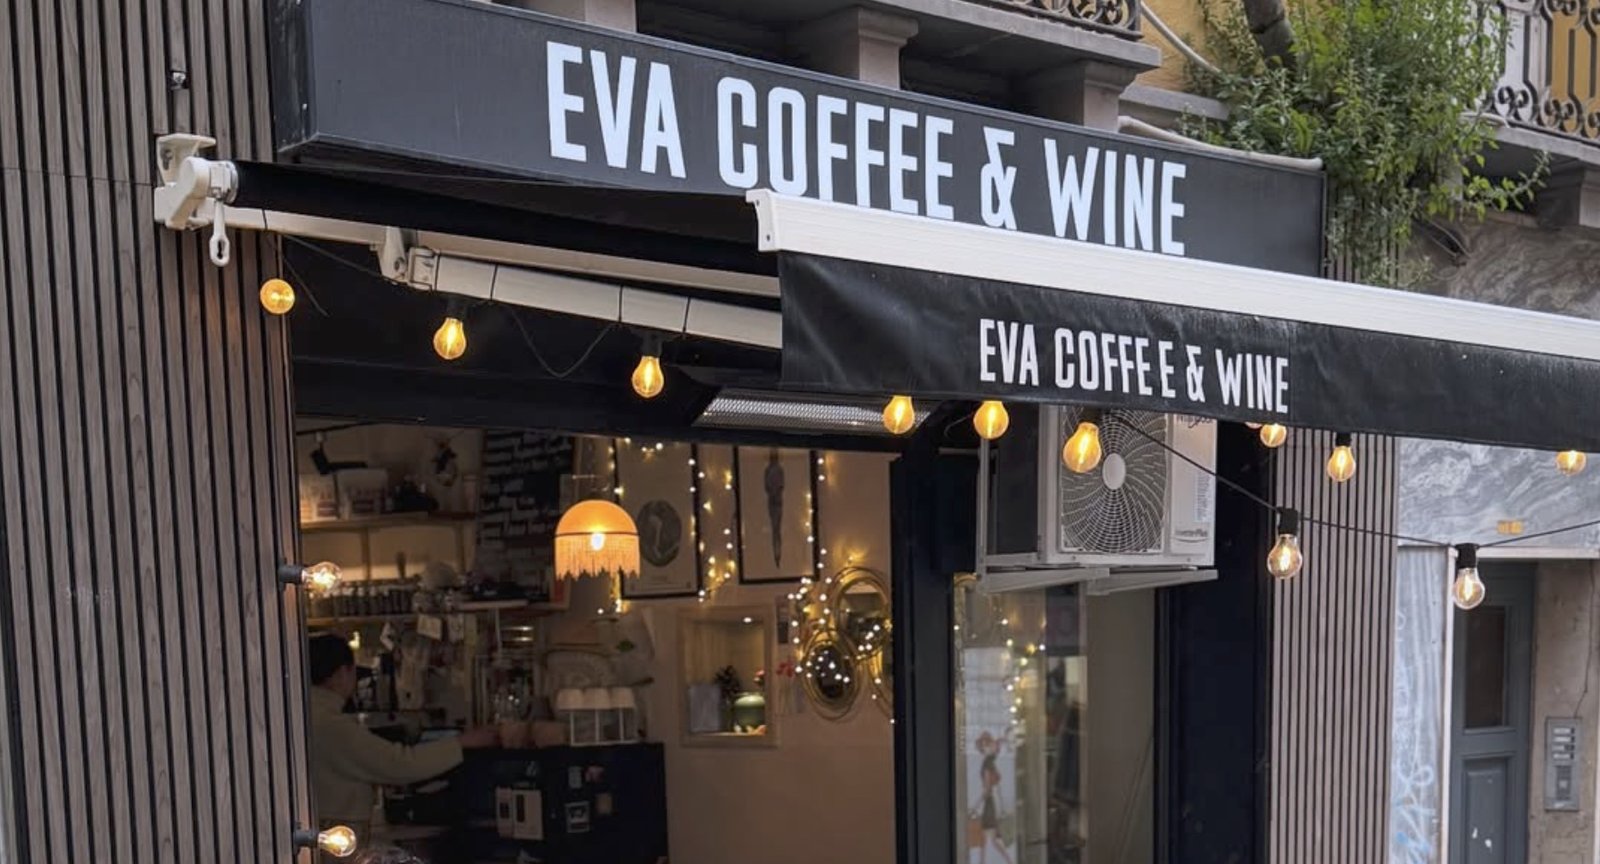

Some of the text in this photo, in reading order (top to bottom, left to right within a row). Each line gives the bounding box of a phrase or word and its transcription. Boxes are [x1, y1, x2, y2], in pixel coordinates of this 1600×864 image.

[547, 41, 1187, 257] EVA COFFEE & WINE
[979, 318, 1040, 387] EVA
[1185, 344, 1206, 403] &
[1214, 348, 1290, 415] WINE
